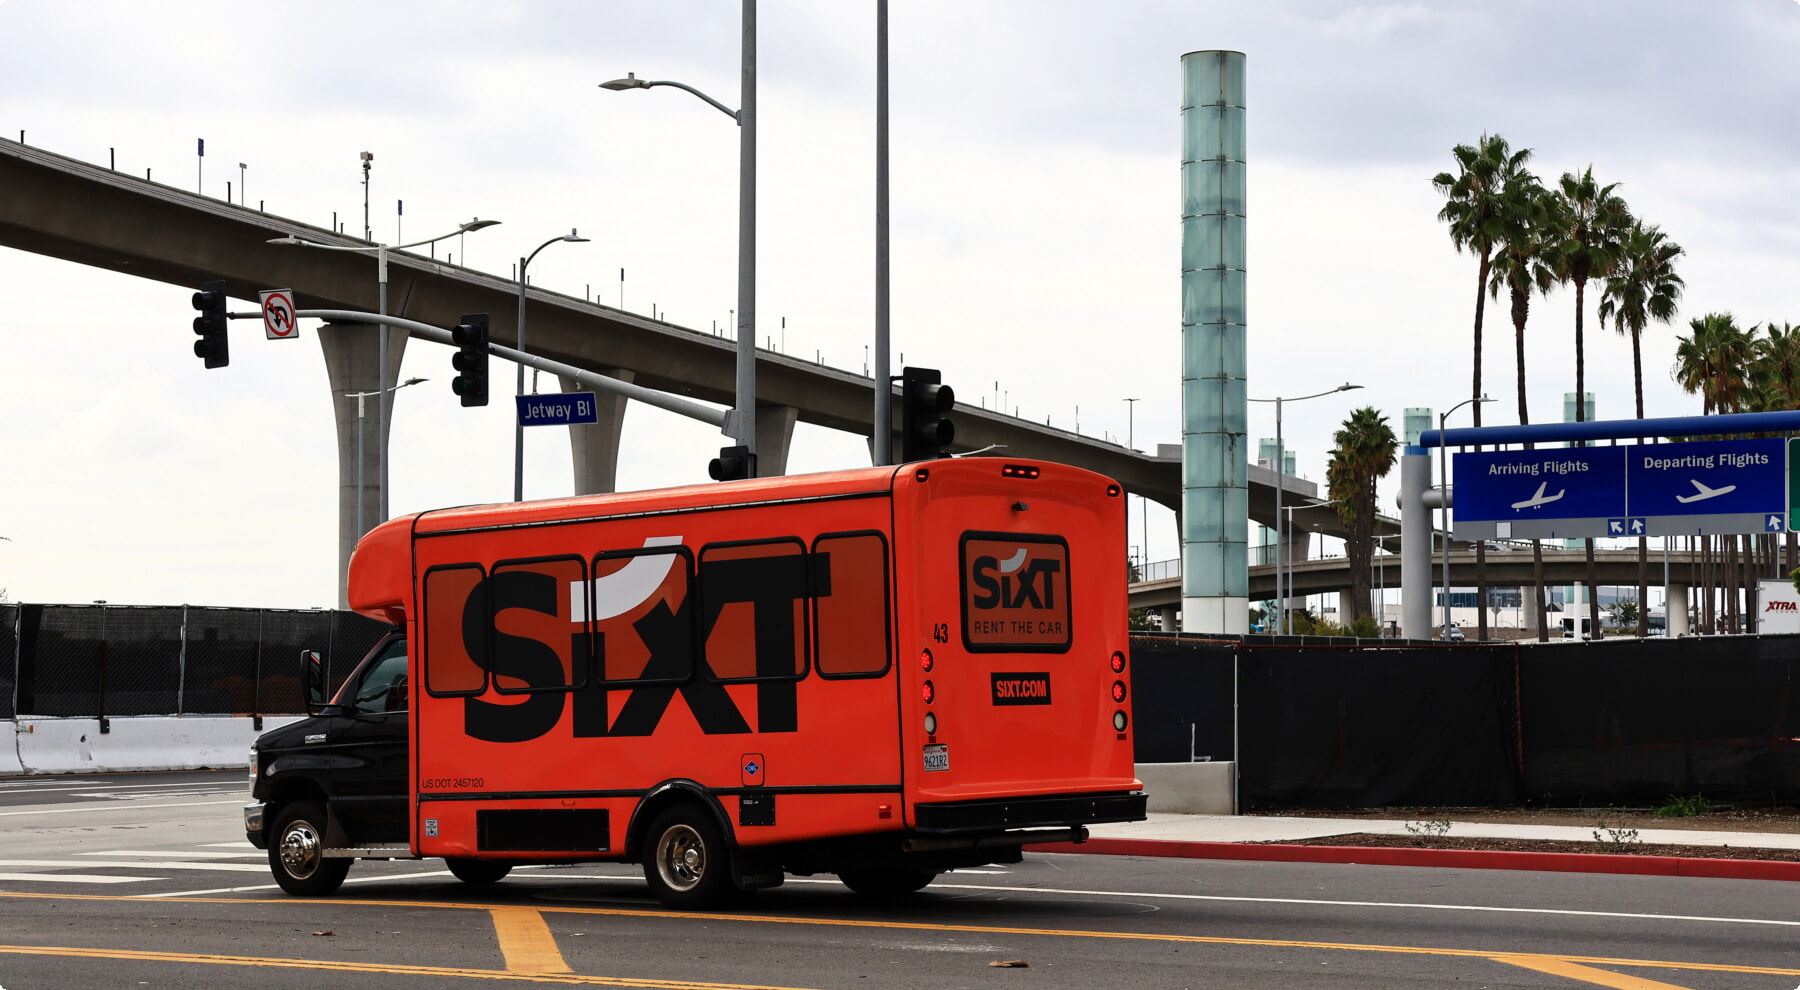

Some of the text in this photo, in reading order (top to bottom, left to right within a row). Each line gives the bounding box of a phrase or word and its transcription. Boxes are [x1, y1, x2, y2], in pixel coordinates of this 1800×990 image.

[524, 400, 591, 421] Jetway Bl
[1488, 460, 1589, 476] Arriving Flights
[1643, 452, 1769, 471] Departing Flights
[1764, 600, 1797, 612] XTRA
[933, 623, 948, 643] 43
[974, 621, 1062, 635] RENT THE CAR
[996, 680, 1047, 698] SIXT.COM
[422, 777, 485, 789] US DOT 2457120
